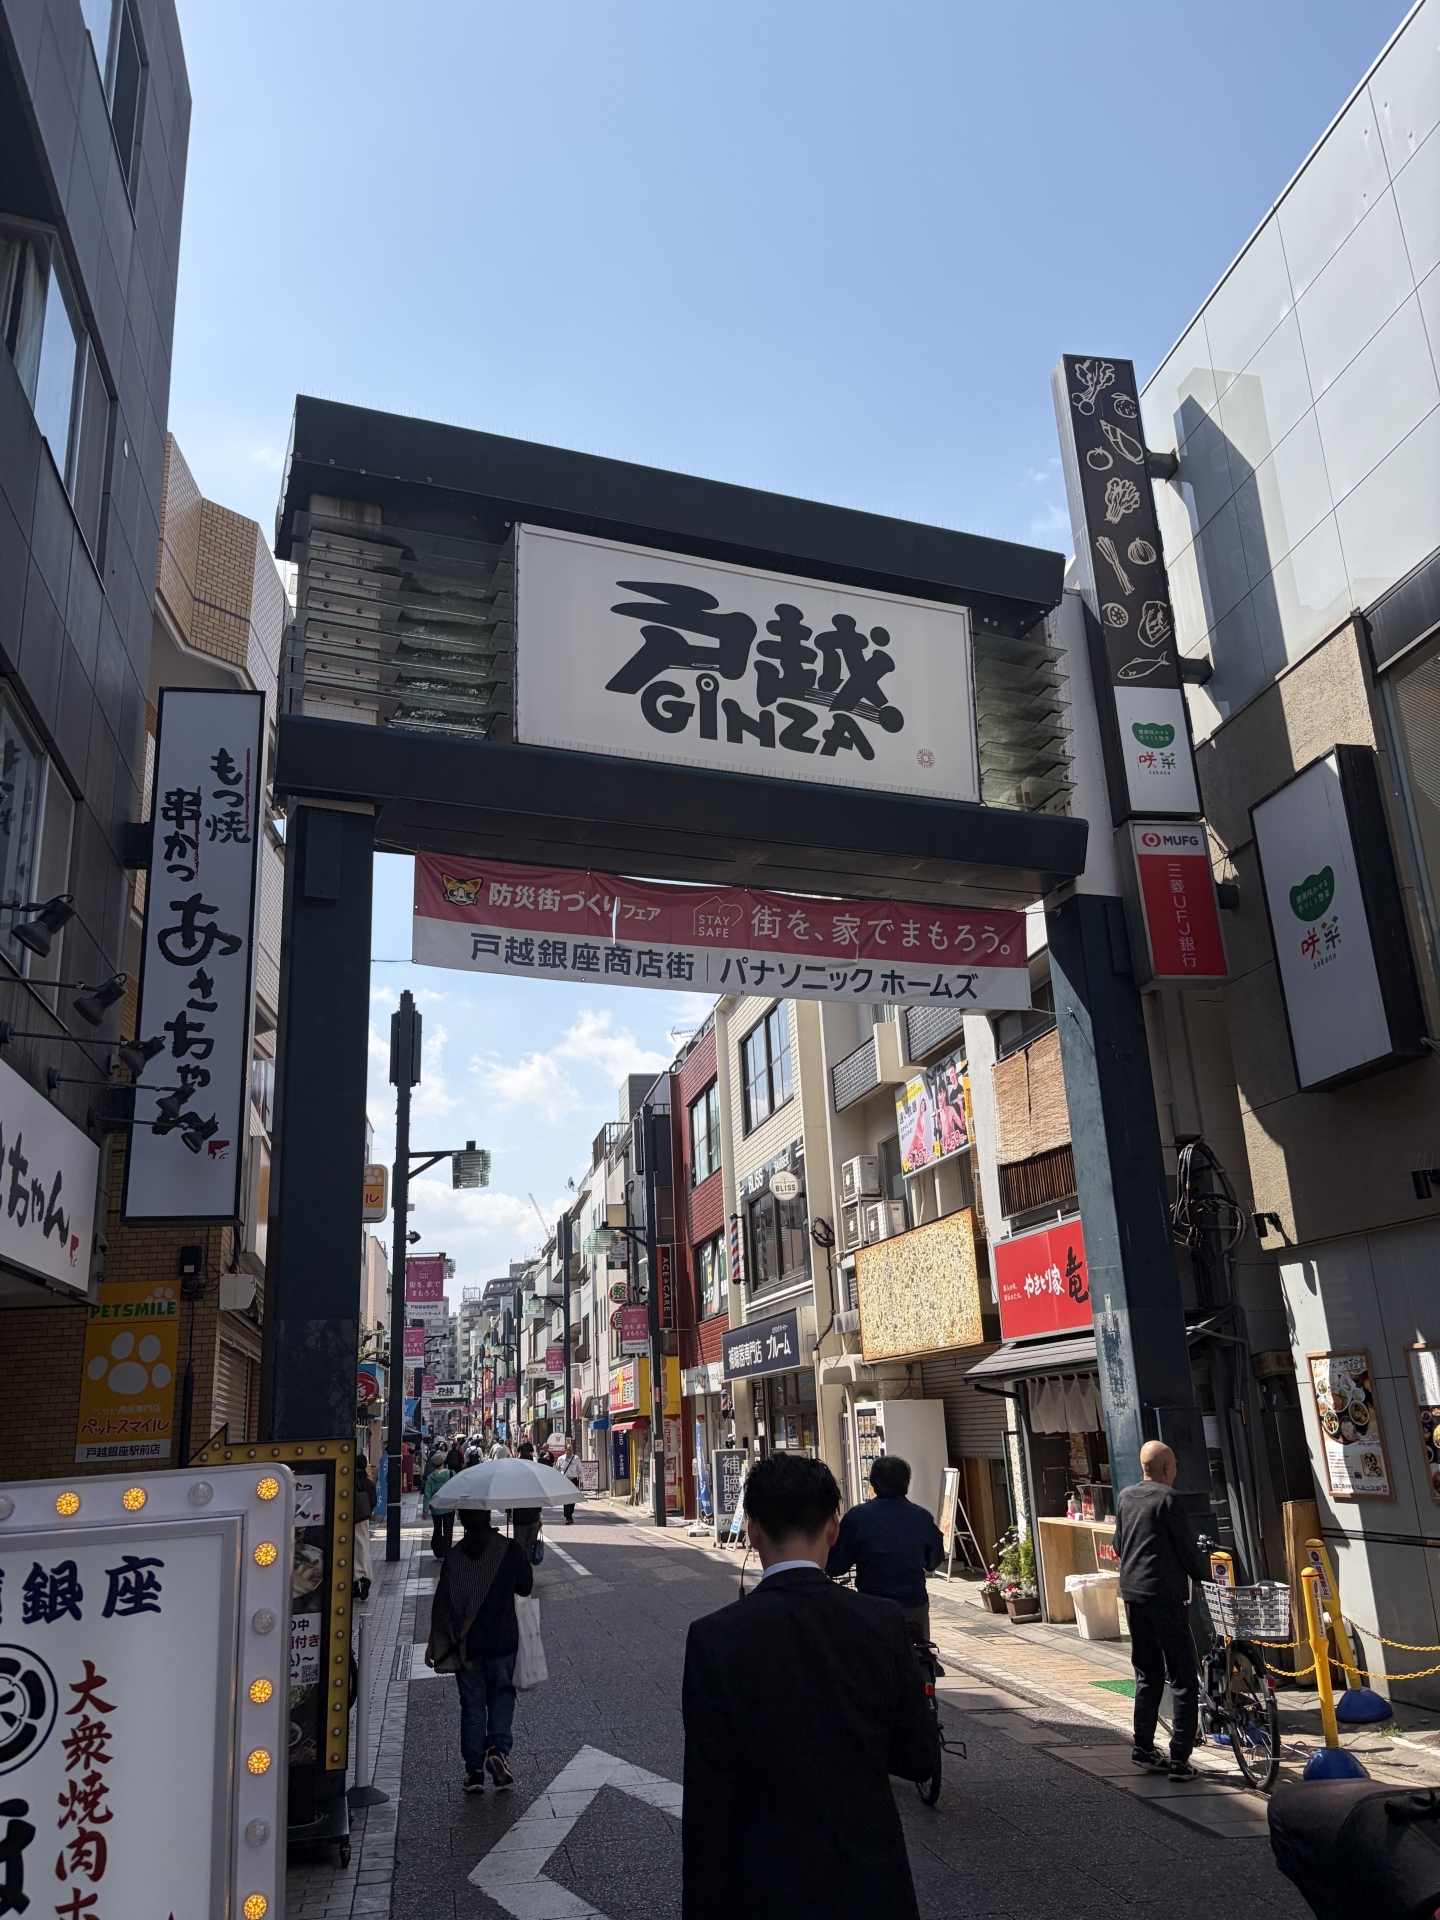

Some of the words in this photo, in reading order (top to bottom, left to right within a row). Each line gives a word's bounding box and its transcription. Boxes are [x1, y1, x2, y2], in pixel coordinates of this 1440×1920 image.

[605, 581, 904, 733] 戸越
[640, 672, 875, 761] GINZA
[205, 747, 251, 843] もつ焼
[161, 787, 201, 882] 串かつ
[1162, 835, 1199, 846] MUFG
[698, 914, 731, 926] STAY
[698, 926, 729, 938] SAFE
[751, 904, 1011, 955] 街を、家でまもろう。
[1167, 863, 1198, 968] 三菱UFJ銀行
[470, 932, 694, 982] 戸越銀座商店街
[720, 956, 873, 993] パナソニック
[880, 969, 979, 1000] ホームズ
[0, 1119, 70, 1248] ちゃん
[748, 1167, 764, 1194] BLISS
[775, 1183, 796, 1192] BLISS
[662, 1257, 670, 1276] ACE
[89, 1300, 177, 1319] PETSMILE
[663, 1285, 671, 1312] CARE
[766, 1332, 792, 1360] ブルーム
[80, 1418, 170, 1436] ペットスマイル
[86, 1443, 161, 1459] 戸越銀座駅前店
[722, 1454, 741, 1512] 補聴器
[0, 1554, 165, 1625] 銀座
